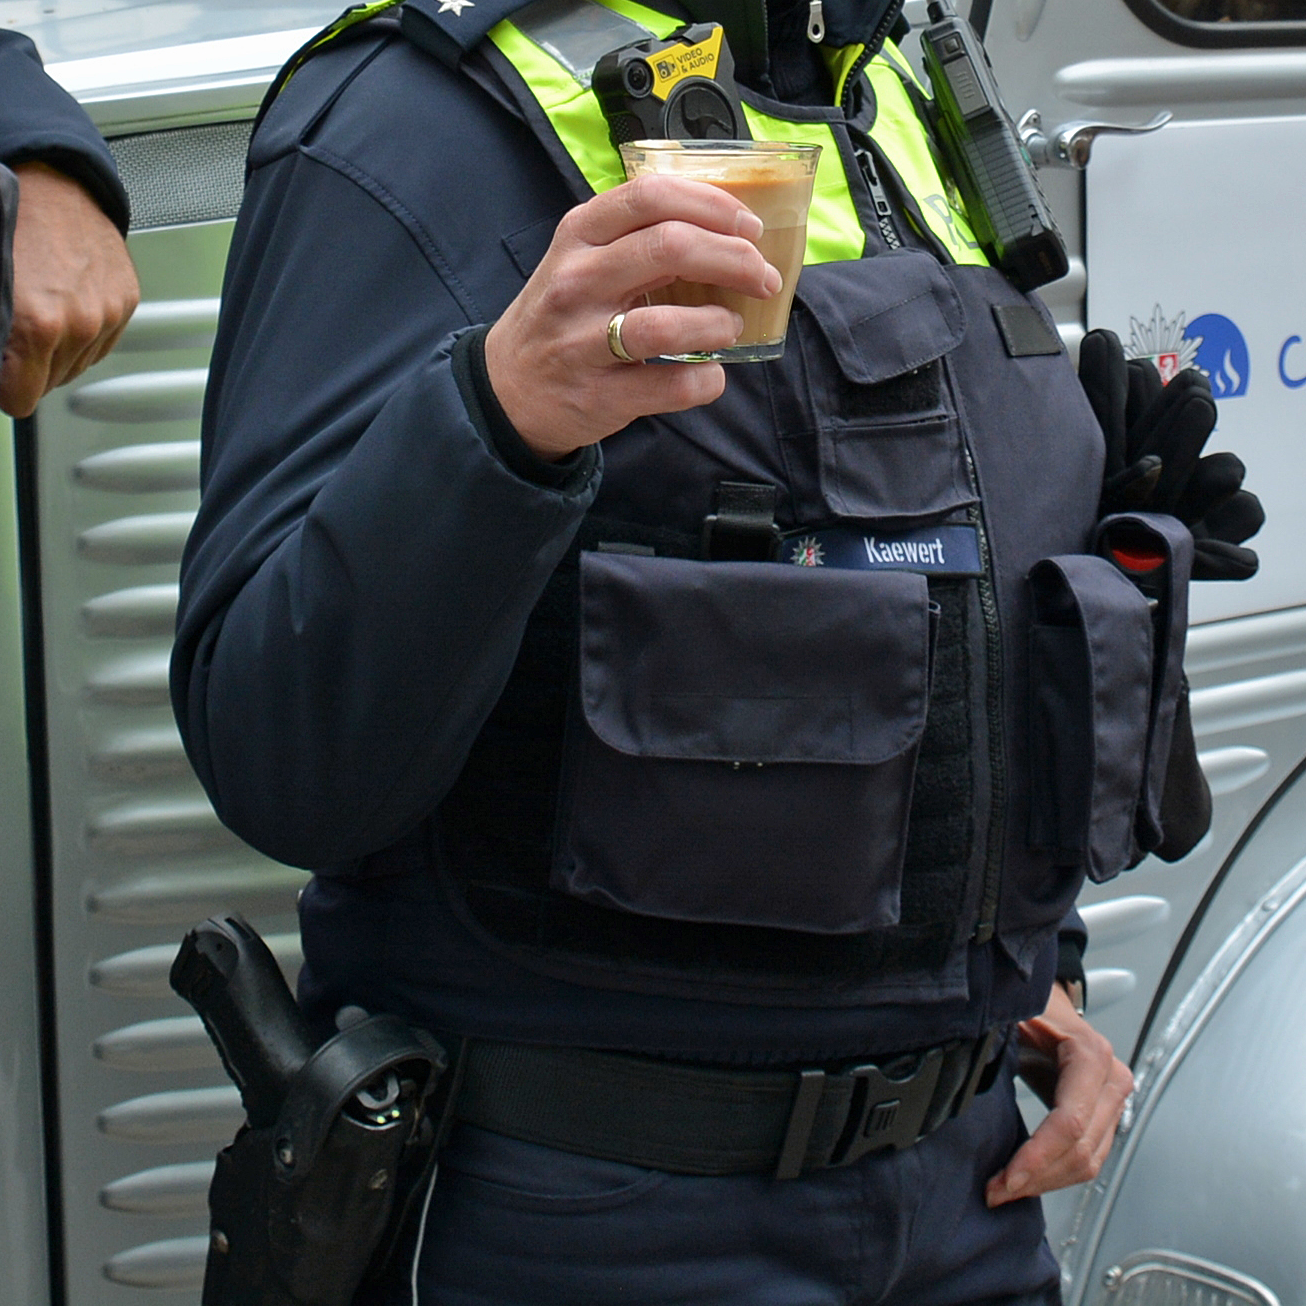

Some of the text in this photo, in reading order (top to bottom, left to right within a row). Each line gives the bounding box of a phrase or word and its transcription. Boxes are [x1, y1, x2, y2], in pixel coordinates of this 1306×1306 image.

[677, 48, 703, 64] VIDEO
[690, 53, 715, 71] AUDIO
[863, 536, 945, 565] Kaewert
